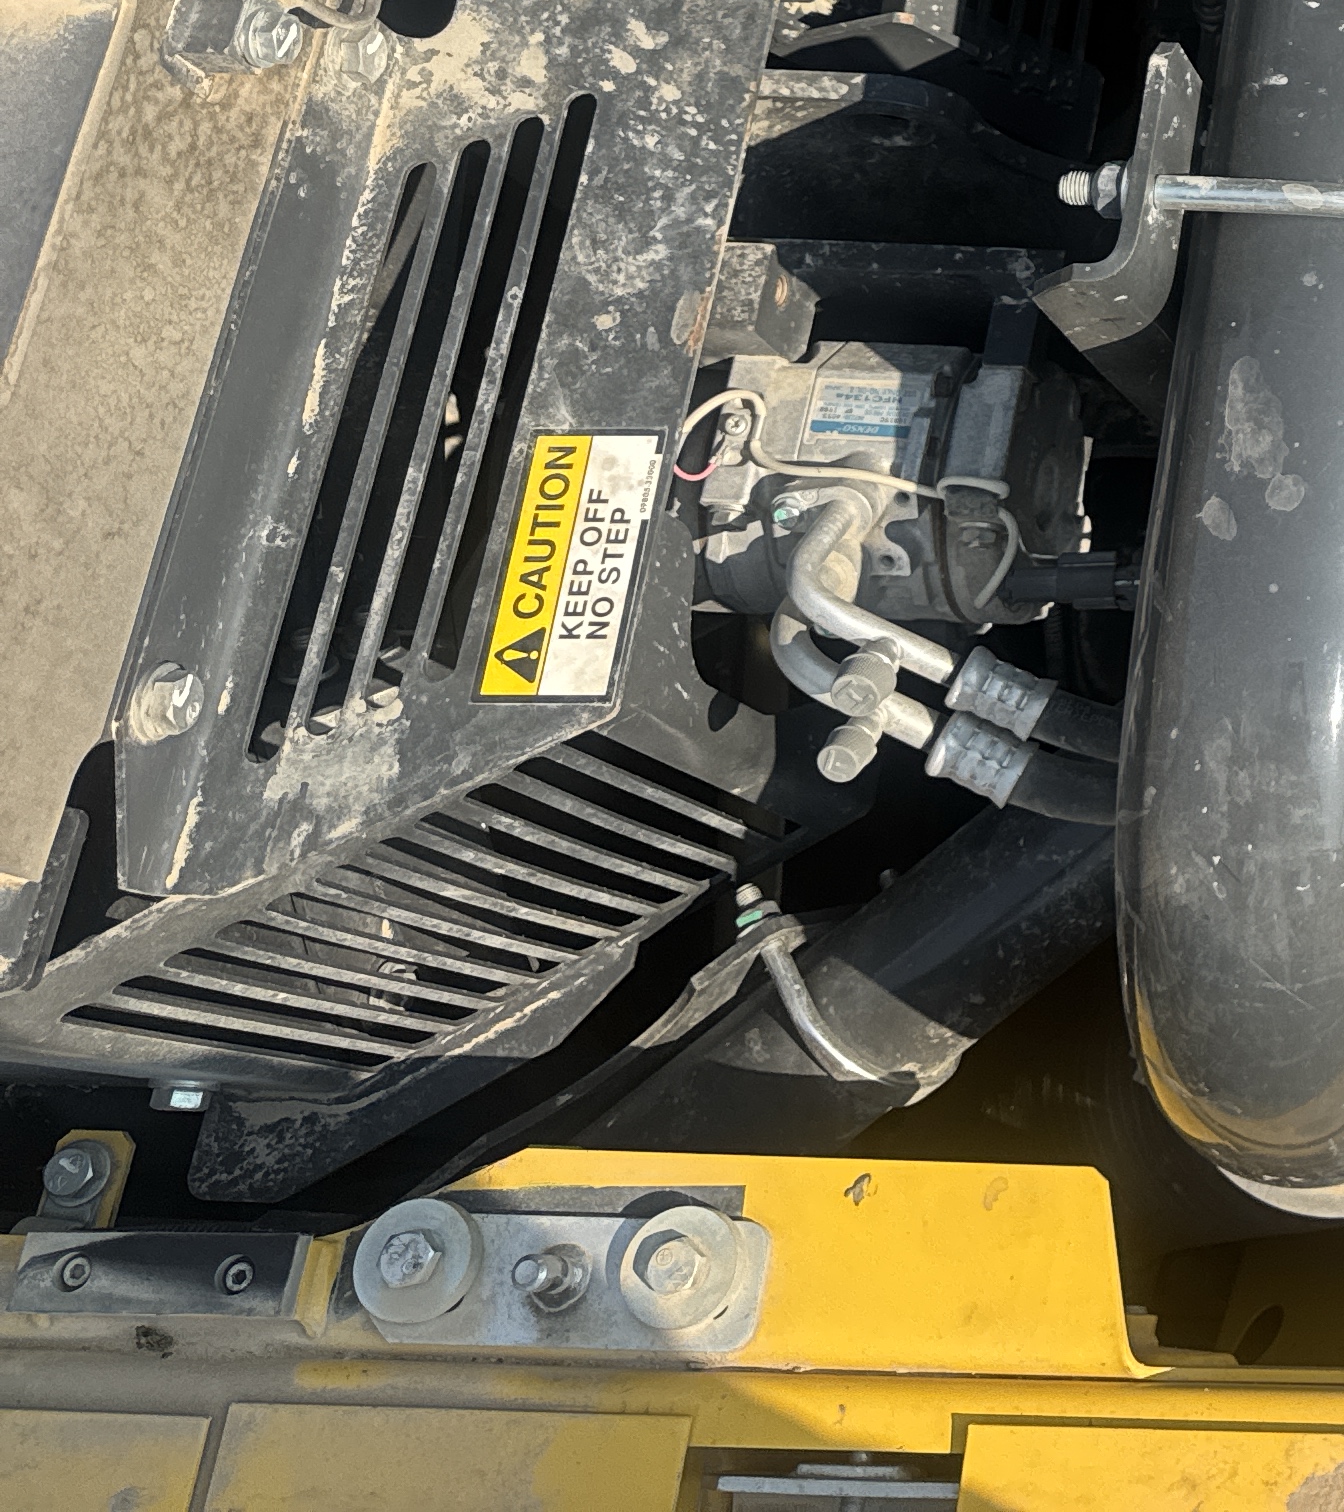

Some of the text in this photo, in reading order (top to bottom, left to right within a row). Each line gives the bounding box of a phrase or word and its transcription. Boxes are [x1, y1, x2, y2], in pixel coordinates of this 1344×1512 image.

[514, 445, 577, 619] CAUTION
[559, 488, 610, 640] KEEP OFF
[587, 507, 631, 640] NO STEP
